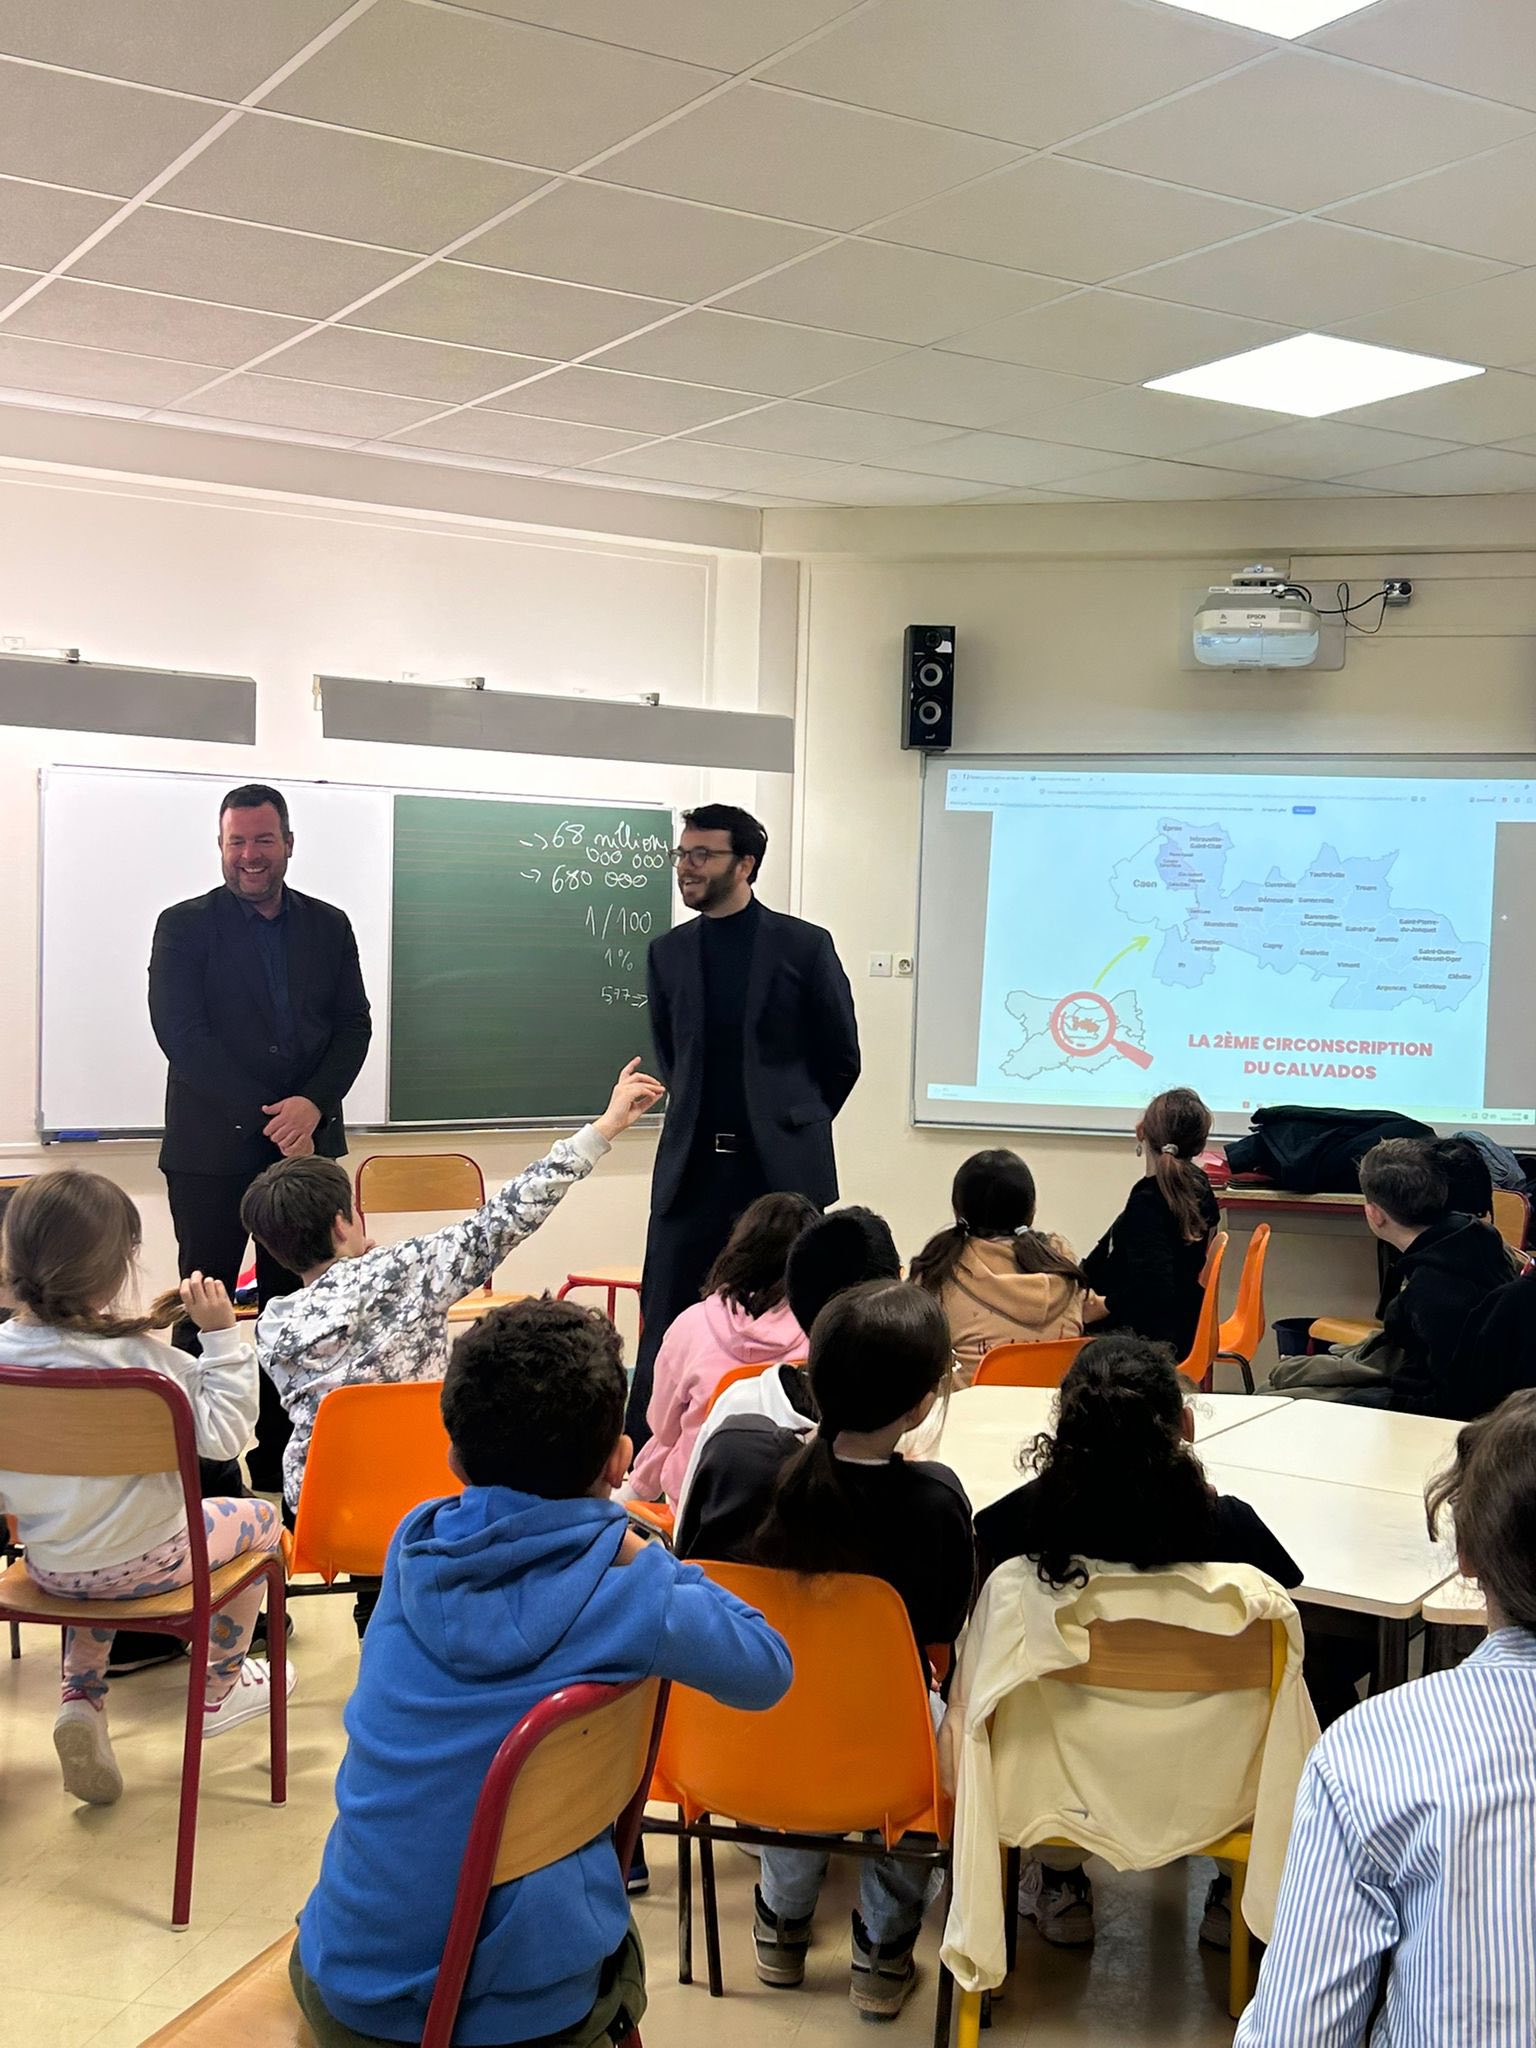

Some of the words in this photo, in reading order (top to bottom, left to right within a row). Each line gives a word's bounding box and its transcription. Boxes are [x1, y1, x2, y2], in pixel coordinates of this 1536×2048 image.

[552, 820, 585, 848] 68
[586, 846, 623, 866] 000
[632, 853, 664, 869] 000
[552, 864, 593, 894] 680
[1133, 879, 1158, 889] Caen
[585, 903, 652, 940] 1/100
[1188, 1034, 1210, 1048] LA
[1213, 1031, 1260, 1051] 2ÈME
[1263, 1036, 1433, 1057] CIRCONSCRIPTION
[1243, 1060, 1271, 1074] DU
[1272, 1062, 1378, 1080] CALVADOS
